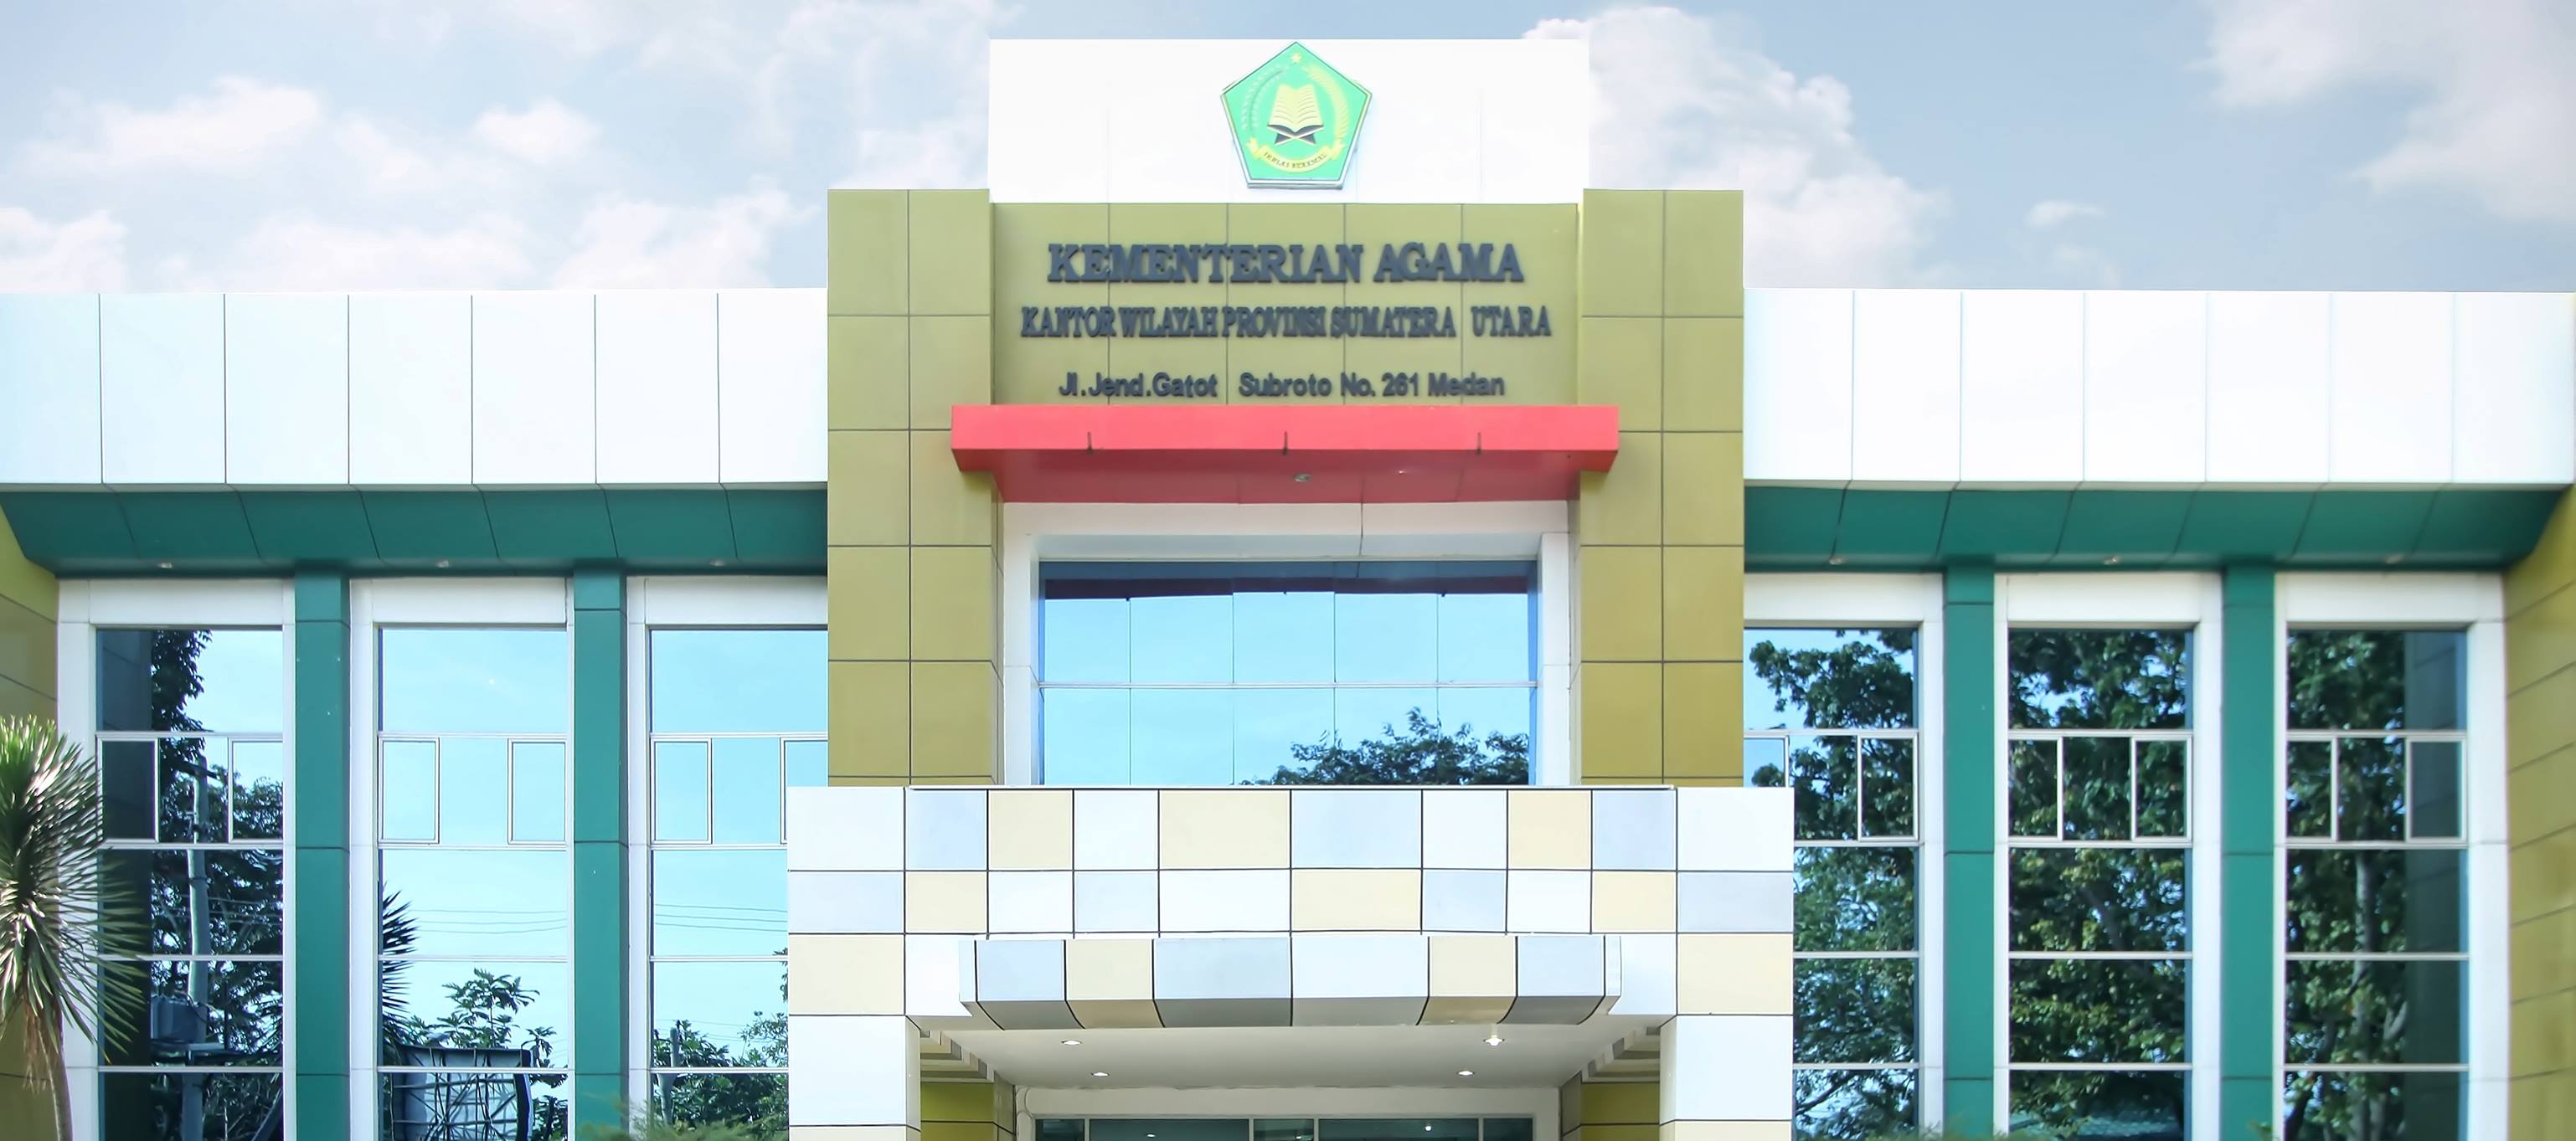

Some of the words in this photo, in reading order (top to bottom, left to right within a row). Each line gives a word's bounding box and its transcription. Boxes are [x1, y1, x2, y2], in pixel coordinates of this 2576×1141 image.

[1047, 242, 1363, 284] KEMENTERIAN
[1373, 242, 1524, 284] AGAMA
[1020, 306, 1117, 338] KANTOR
[1118, 306, 1219, 338] WILAYAH
[1221, 306, 1327, 338] PROVINSI
[1330, 306, 1457, 339] SUMATERA
[1471, 306, 1552, 337] UTARA
[1239, 372, 1333, 398] Subroto
[1340, 372, 1376, 398] No.
[1381, 372, 1419, 398] 261
[1428, 372, 1505, 398] Medan
